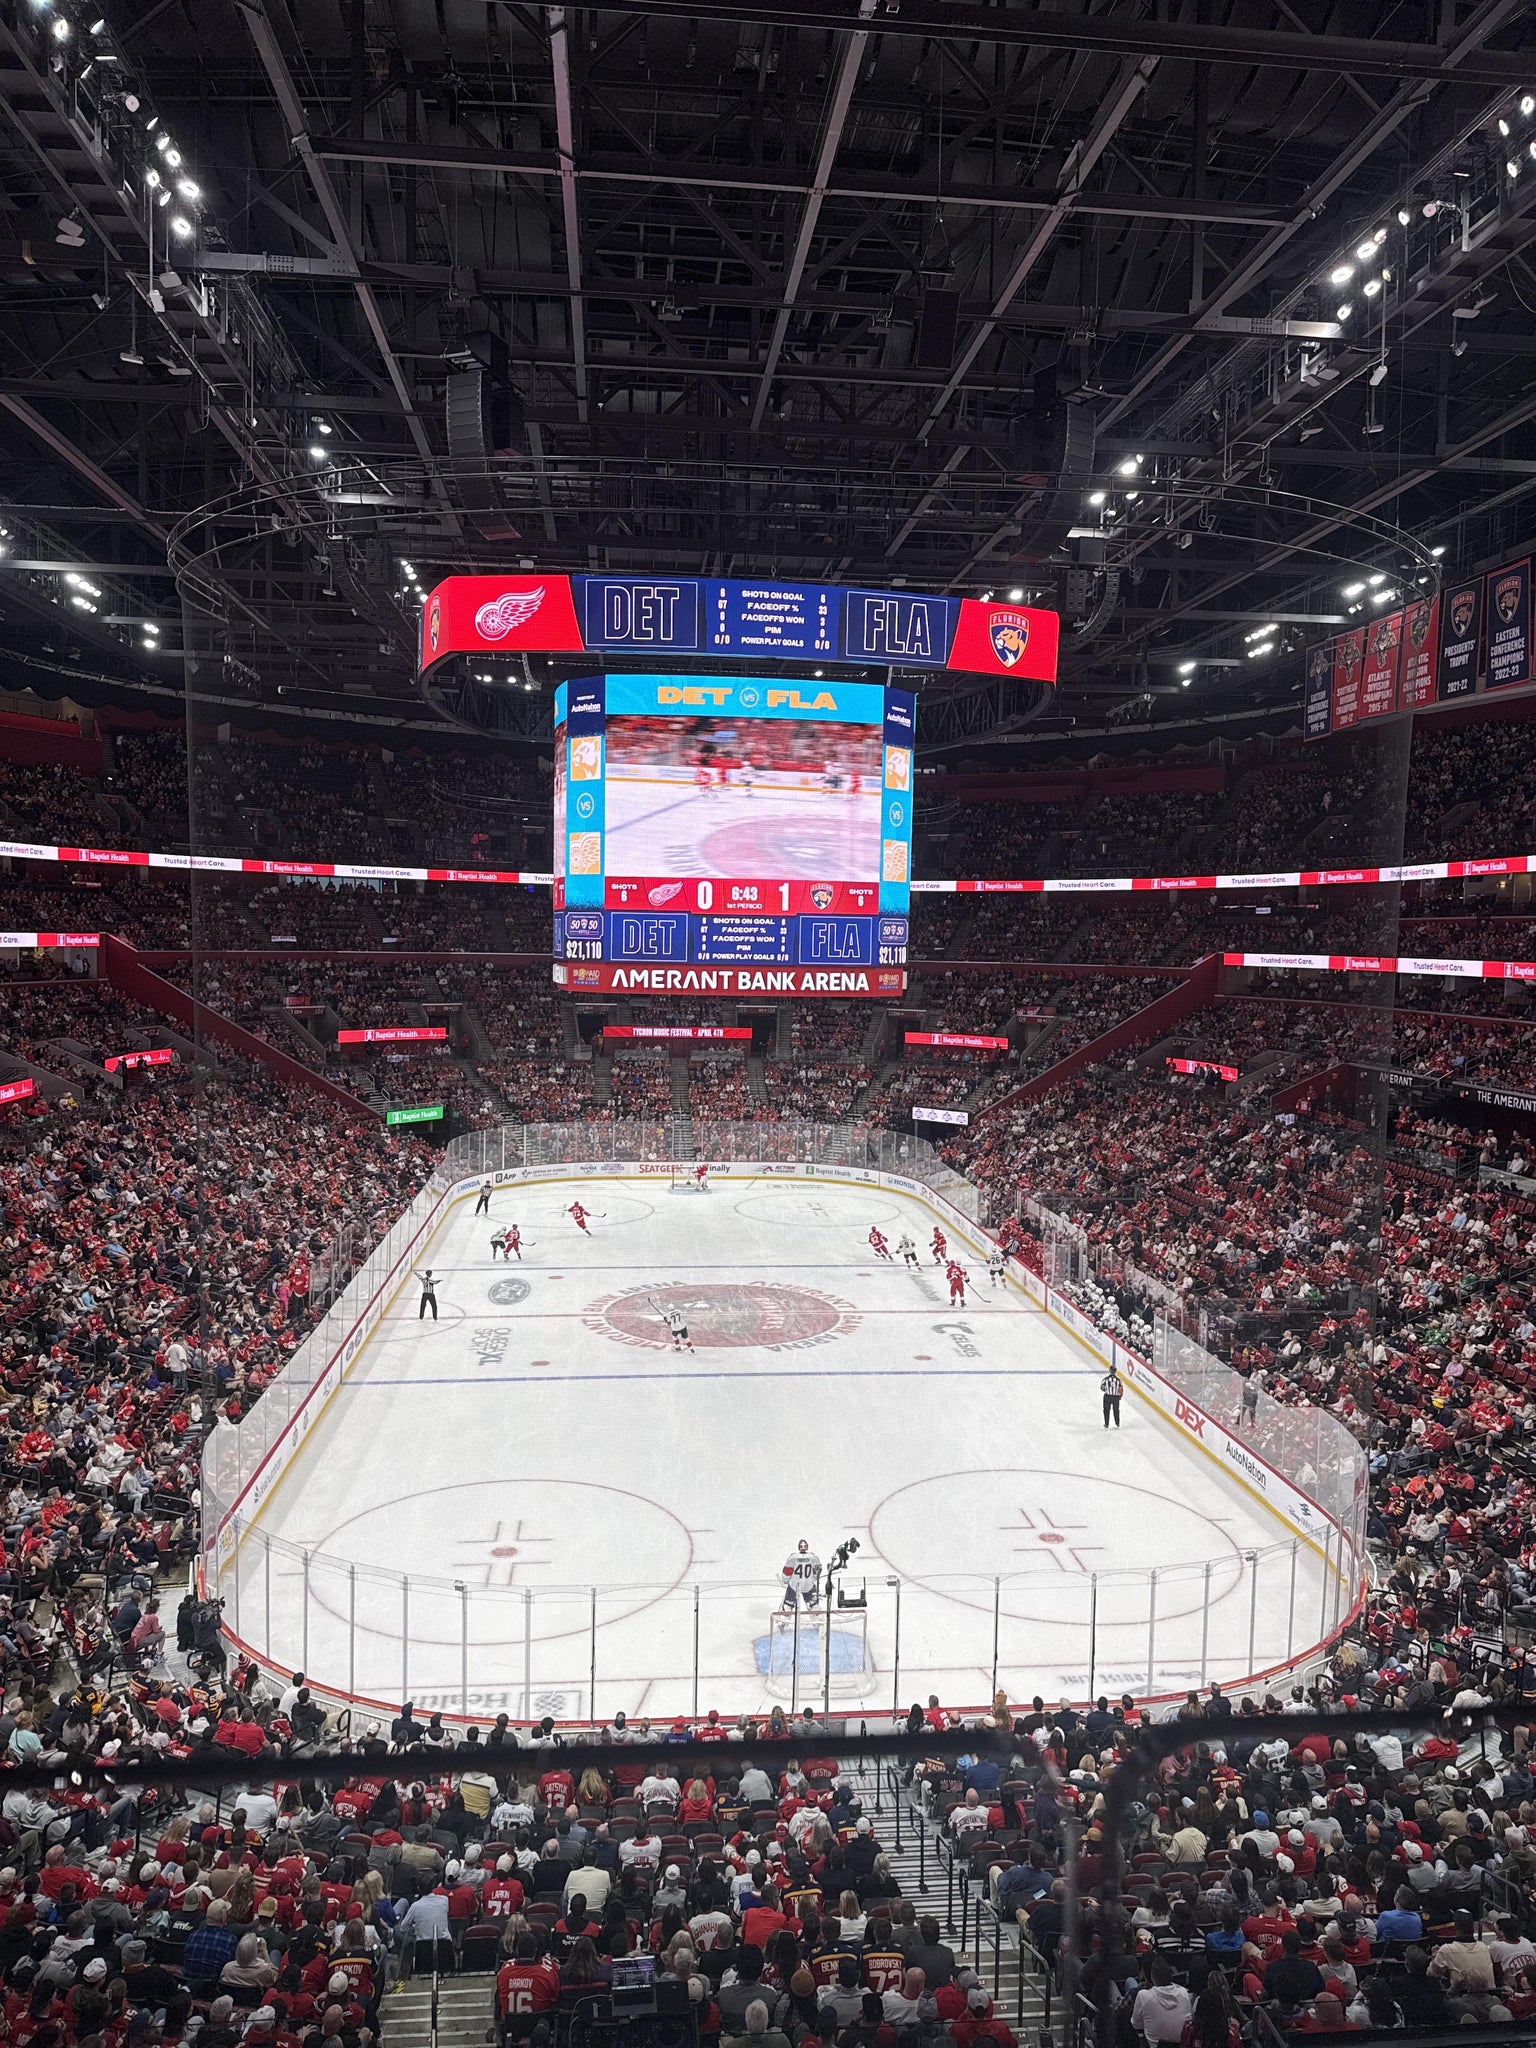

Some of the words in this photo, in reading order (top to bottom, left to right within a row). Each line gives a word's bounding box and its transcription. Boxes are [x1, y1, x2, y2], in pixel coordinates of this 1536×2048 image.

[741, 590, 770, 599] SHOTS
[771, 592, 782, 600] ON
[783, 592, 805, 601] GOAL
[604, 585, 680, 641] DET
[718, 600, 728, 609] 67
[747, 602, 791, 612] FACEOFF
[818, 605, 828, 615] 33
[741, 613, 785, 623] FACEOFFS
[785, 616, 805, 624] WON
[992, 615, 1027, 628] FLORIDA
[719, 623, 726, 633] 0
[764, 626, 782, 635] PIM
[820, 628, 826, 638] 0
[863, 598, 931, 656] FLA
[1495, 626, 1520, 643] EASTERN
[714, 634, 731, 645] 0/0
[741, 636, 765, 645] POWER
[765, 637, 782, 646] PLAY
[782, 639, 804, 648] GOALS
[814, 640, 830, 650] 0/0
[1490, 637, 1525, 656] CONFERENCE
[1449, 654, 1469, 669] TROPHY
[1490, 651, 1524, 669] CHAMPIONS
[1367, 669, 1392, 683] ATLANTIC
[1495, 664, 1519, 680] 2022-23
[1447, 678, 1468, 694] 2021-22
[657, 686, 733, 706] DET
[767, 689, 838, 711] FLA
[1363, 689, 1393, 704] CHAMPIONS
[90, 851, 111, 860] Baptist
[111, 853, 130, 861] Health
[164, 857, 188, 865] Trusted
[274, 864, 294, 872] Baptist
[1471, 864, 1489, 872] Baptist
[1489, 862, 1507, 870] Health
[457, 872, 479, 881] Baptist
[480, 873, 497, 881] Health
[1327, 874, 1346, 882] Baptist
[1346, 872, 1364, 880] Health
[984, 882, 1004, 890] Baptist
[1160, 880, 1179, 888] Baptist
[621, 890, 628, 902] 6
[697, 880, 713, 910] 0
[732, 886, 758, 901] 6:43
[778, 882, 789, 911] 1
[858, 895, 864, 907] 6
[570, 920, 581, 929] 50
[588, 920, 598, 929] 50
[66, 936, 83, 944] Baptist
[83, 935, 98, 944] Health
[622, 919, 677, 955] DET
[811, 922, 861, 958] FLA
[566, 940, 602, 961] $21,110
[879, 946, 907, 966] $21,110
[1281, 957, 1297, 965] Heart
[1413, 962, 1433, 970] Trusted
[1433, 963, 1449, 971] Heart
[1514, 966, 1535, 976] Baptist
[611, 968, 734, 989] AMERANT
[737, 971, 796, 991] BANK
[800, 972, 869, 991] ARENA
[375, 1031, 396, 1040] Baptist
[397, 1030, 418, 1038] Health
[653, 1028, 670, 1037] MUSIC
[670, 1028, 693, 1037] FESTIVAL
[698, 1029, 712, 1037] APRIL
[943, 1036, 964, 1045] Baptist
[964, 1037, 983, 1046] Health
[1477, 1090, 1492, 1104] THE
[1493, 1094, 1536, 1112] AMERANT
[402, 1112, 420, 1121] Baptist
[421, 1110, 438, 1118] Health
[639, 1164, 684, 1174] SEATGEEK
[834, 1169, 852, 1177] Health
[460, 1180, 481, 1191] HONDA
[893, 1178, 916, 1190] HONDA
[990, 1256, 1001, 1265] 26
[666, 1312, 681, 1324] 77
[763, 1334, 840, 1352] ARENA
[1174, 1398, 1206, 1439] DEX
[1225, 1440, 1267, 1488] AutoNation
[794, 1564, 812, 1578] 40
[547, 1793, 566, 1808] 13
[491, 1890, 510, 1899] LARKIN
[487, 1900, 510, 1917] 71
[509, 1978, 534, 1989] BARKOV
[869, 1970, 901, 1992] 72
[507, 1991, 534, 2014] 16
